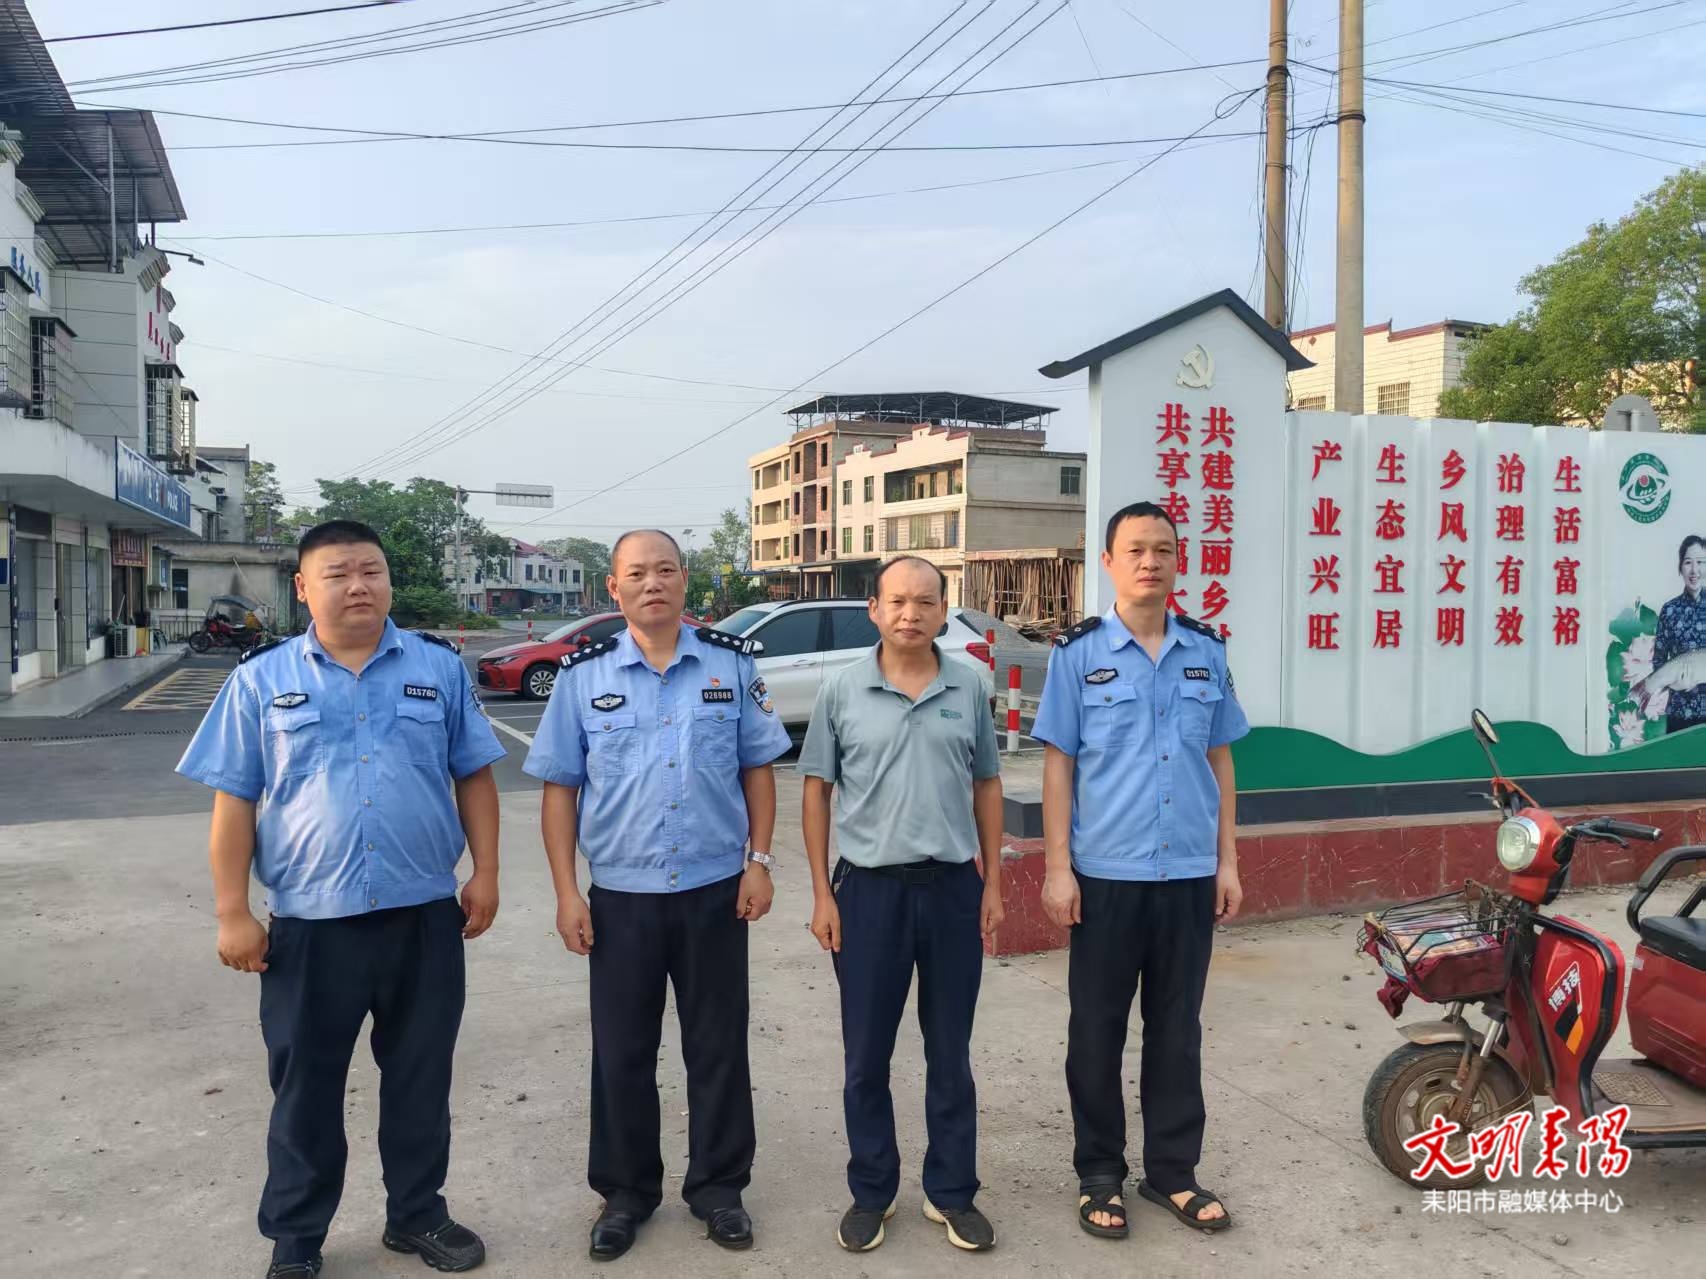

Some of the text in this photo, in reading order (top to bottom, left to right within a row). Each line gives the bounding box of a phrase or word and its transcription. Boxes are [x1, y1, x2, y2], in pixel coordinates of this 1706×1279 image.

[1308, 440, 1342, 650] 产业兴旺
[1373, 444, 1406, 649] 生态宜居
[1437, 449, 1467, 646] 乡风文明
[1494, 453, 1525, 646] 治理有效
[1552, 456, 1582, 646] 生活富裕
[406, 686, 437, 698] 015760
